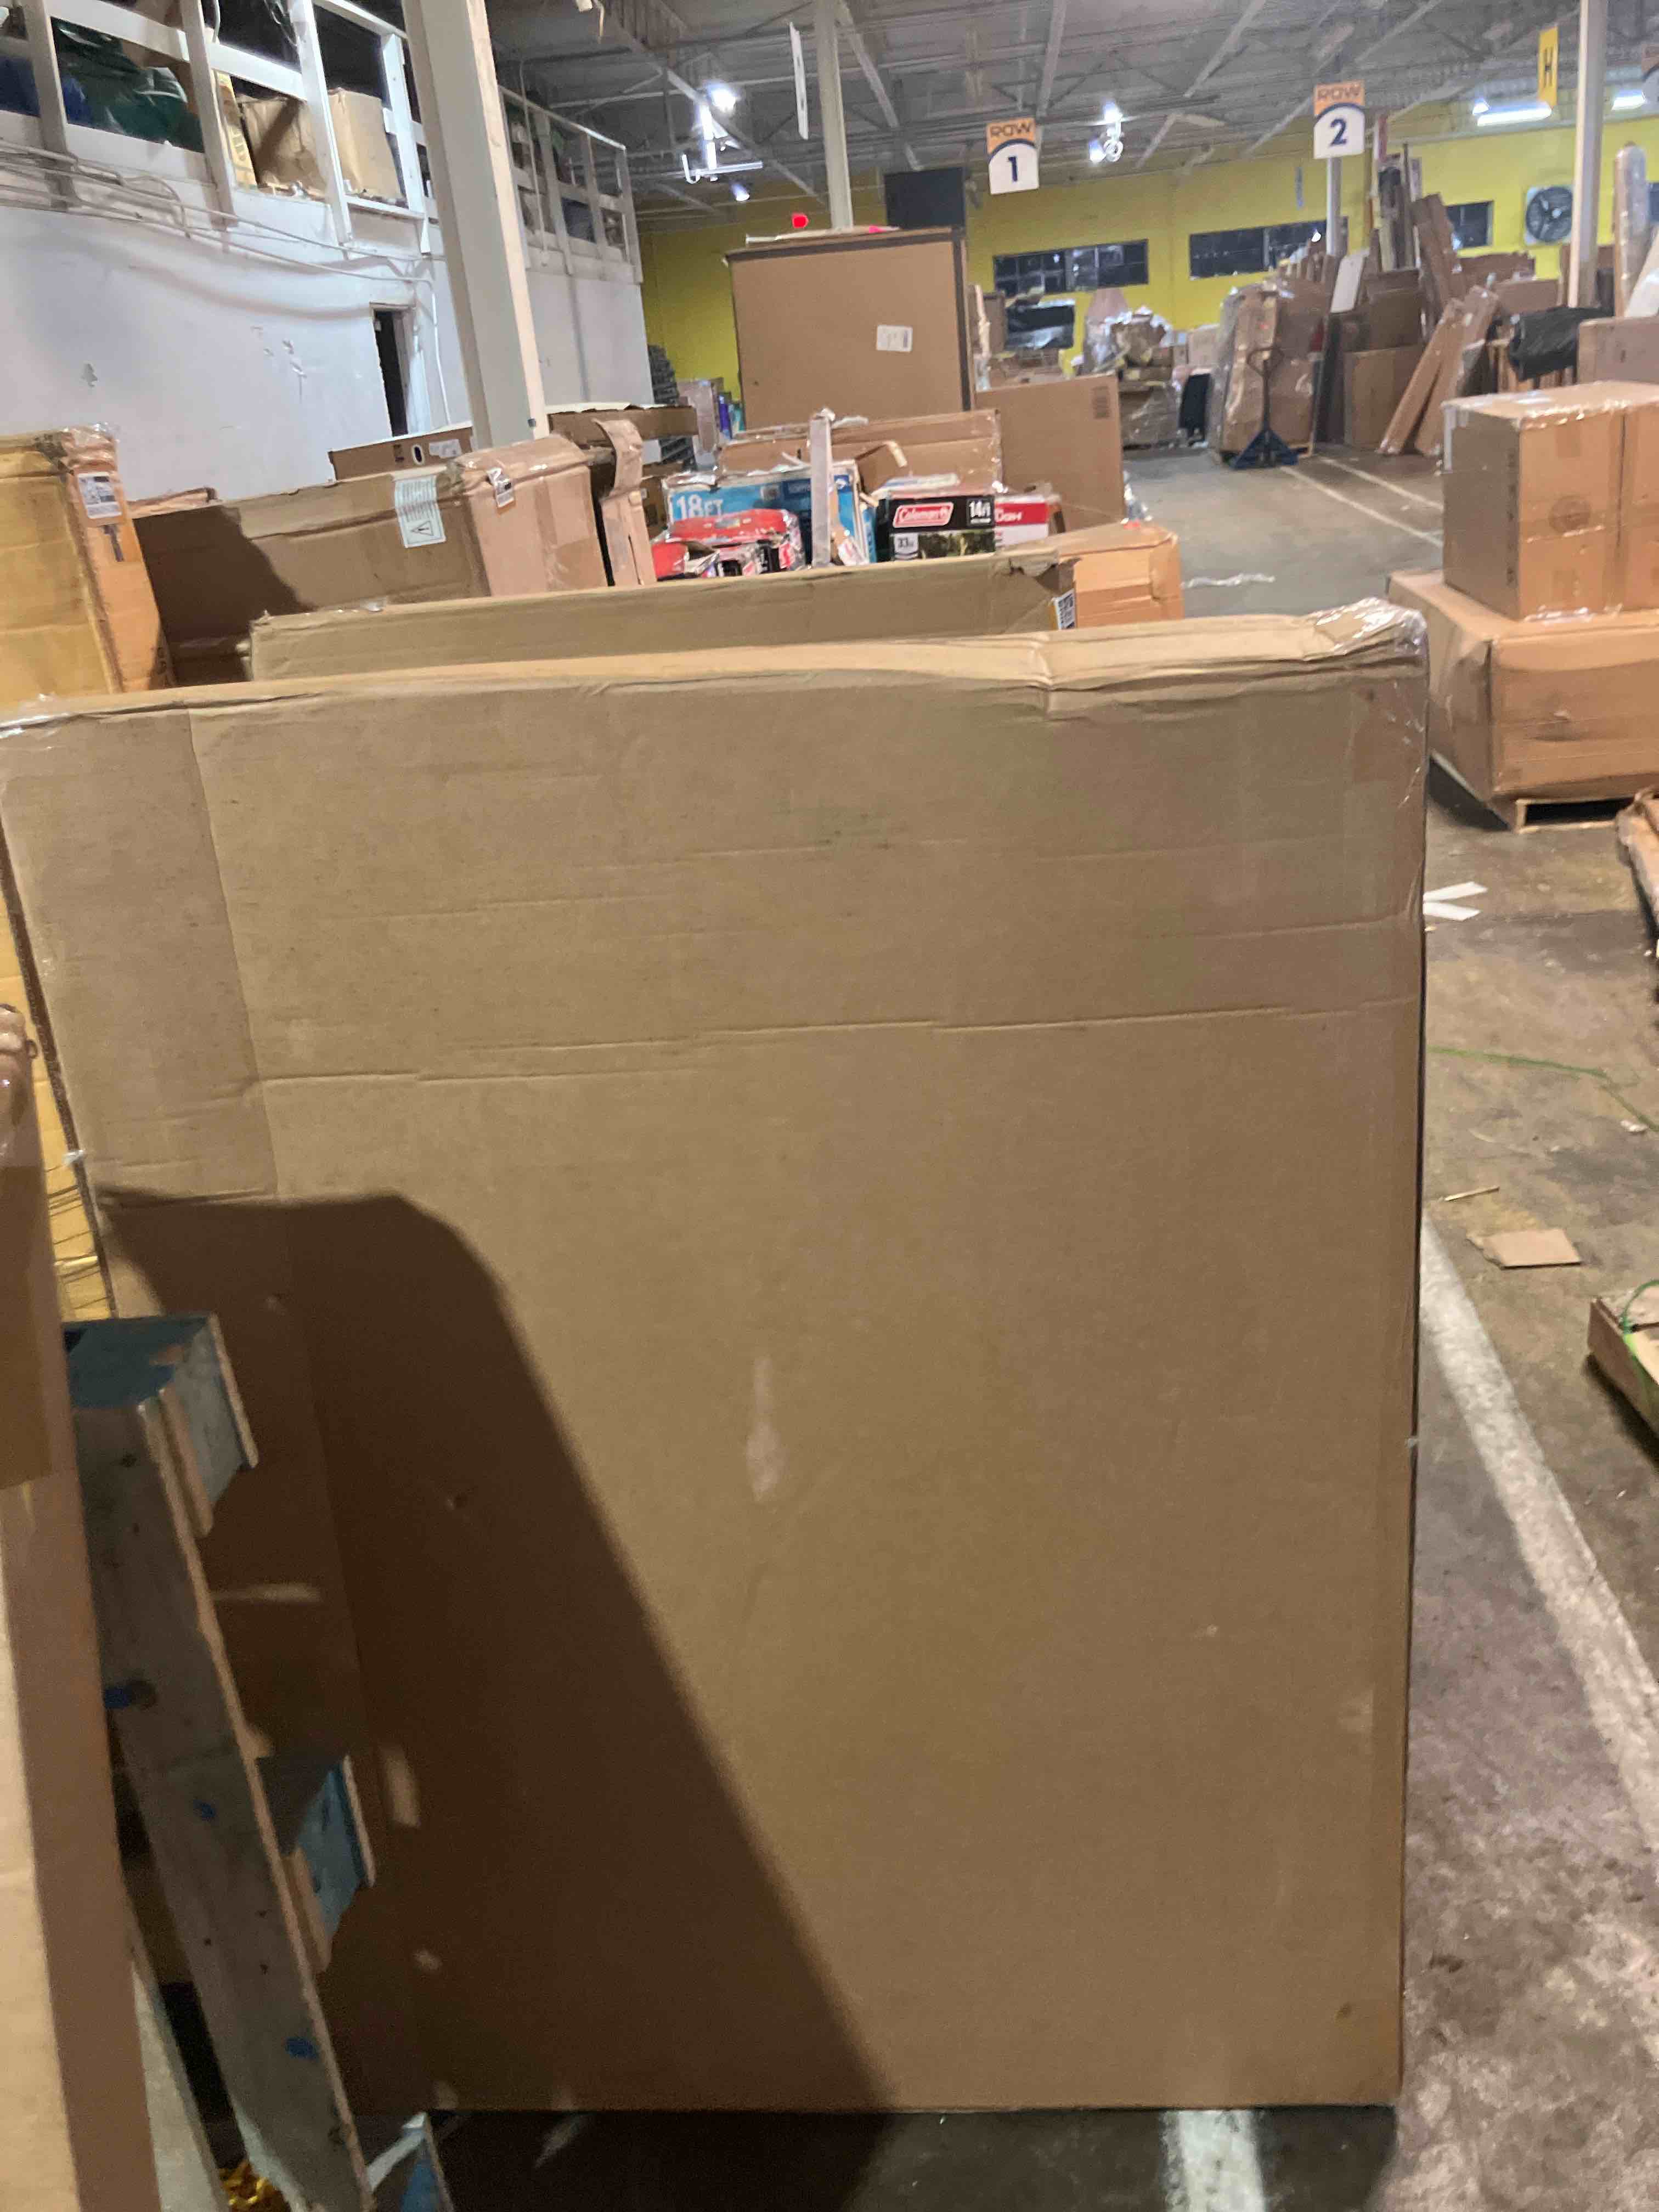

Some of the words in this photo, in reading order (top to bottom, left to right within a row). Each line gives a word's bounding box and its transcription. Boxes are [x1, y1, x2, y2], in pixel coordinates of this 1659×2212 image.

[1318, 87, 1359, 100] ROW
[990, 122, 1031, 137] ROW
[1330, 118, 1347, 146] 2
[1008, 156, 1018, 182] 1
[898, 507, 950, 523] Coleman
